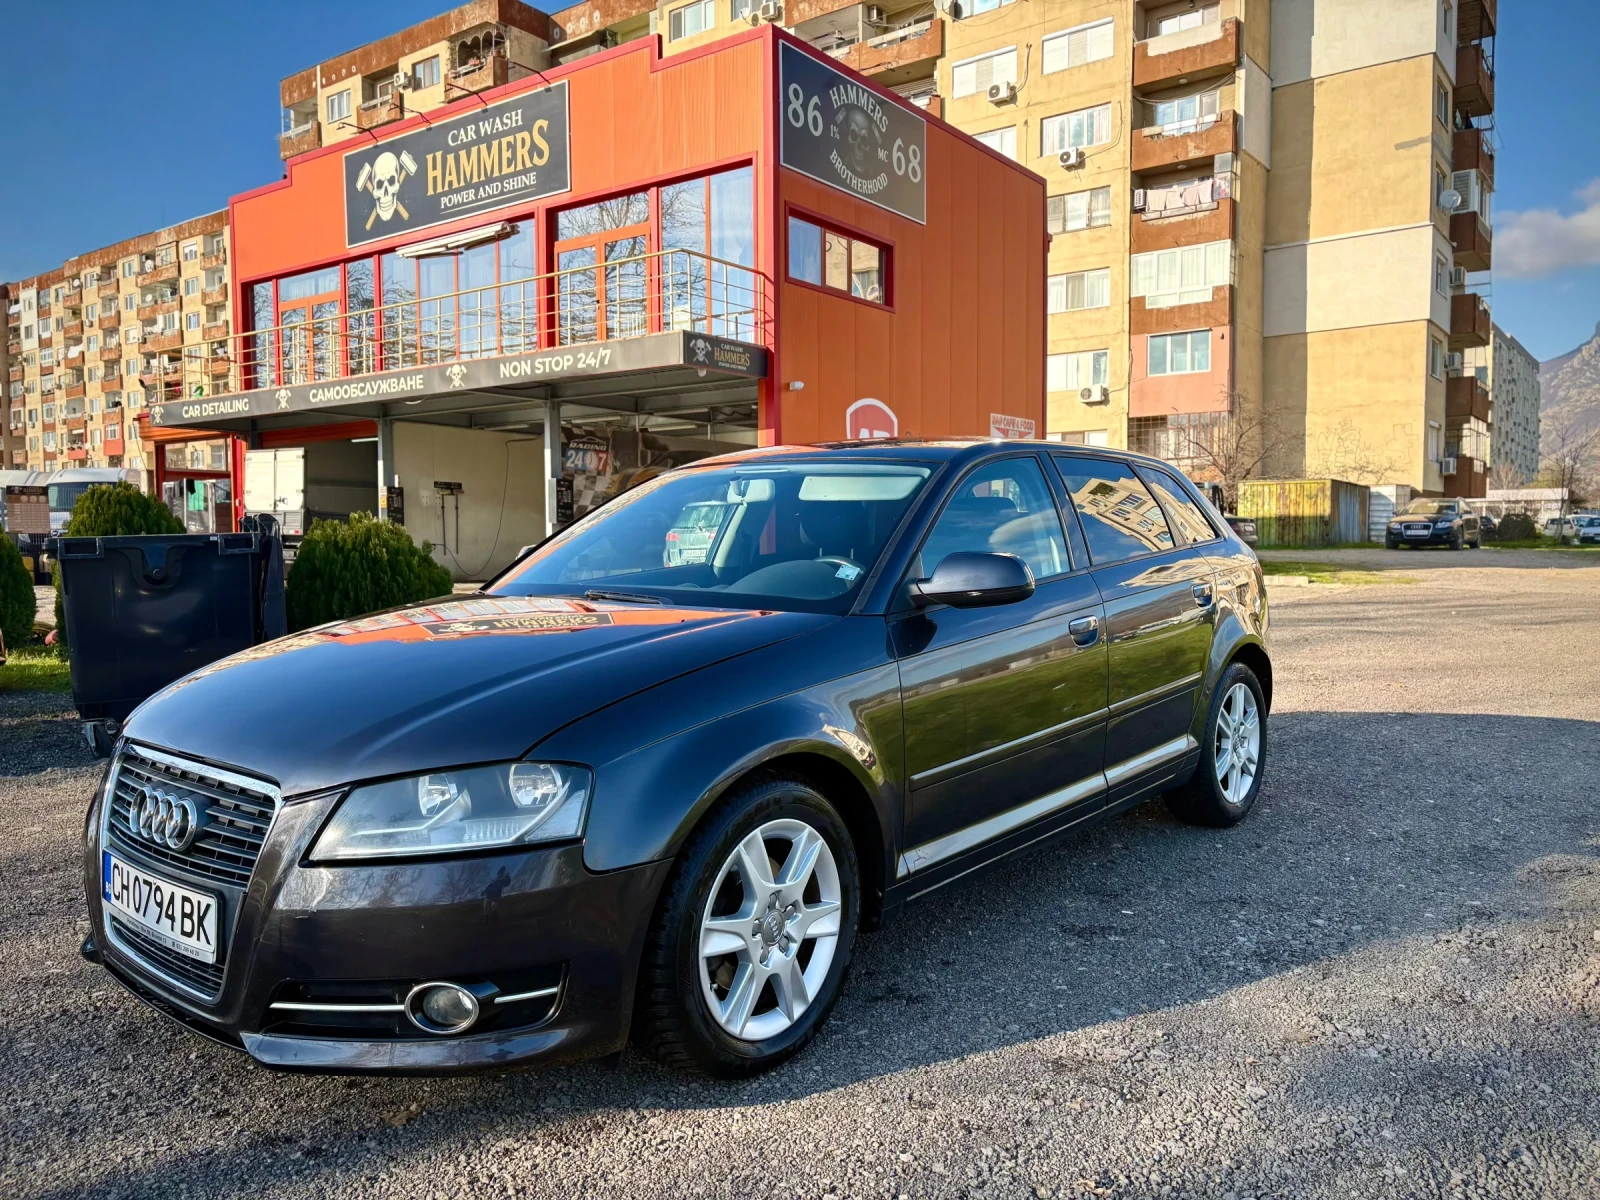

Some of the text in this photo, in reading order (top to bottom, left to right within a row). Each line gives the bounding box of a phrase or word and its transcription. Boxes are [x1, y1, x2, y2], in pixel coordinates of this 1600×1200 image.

[787, 82, 824, 137] 86
[829, 84, 889, 133] HAMMERS
[447, 109, 523, 147] CAR WASH
[425, 118, 550, 196] HAMMERS
[877, 147, 889, 163] MC
[892, 137, 922, 183] 68
[829, 149, 889, 194] BROTHERHOOD
[439, 172, 537, 209] POWER AND SHINE
[499, 347, 611, 379] NON STOP 24/7
[714, 346, 751, 367] HAMMERS
[309, 375, 424, 403] САМООБСЛУЖВАНЕ
[182, 398, 249, 418] CAR DETAILING
[1020, 420, 1034, 431] FOOD
[566, 450, 607, 470] 24 7
[569, 442, 607, 451] RACING
